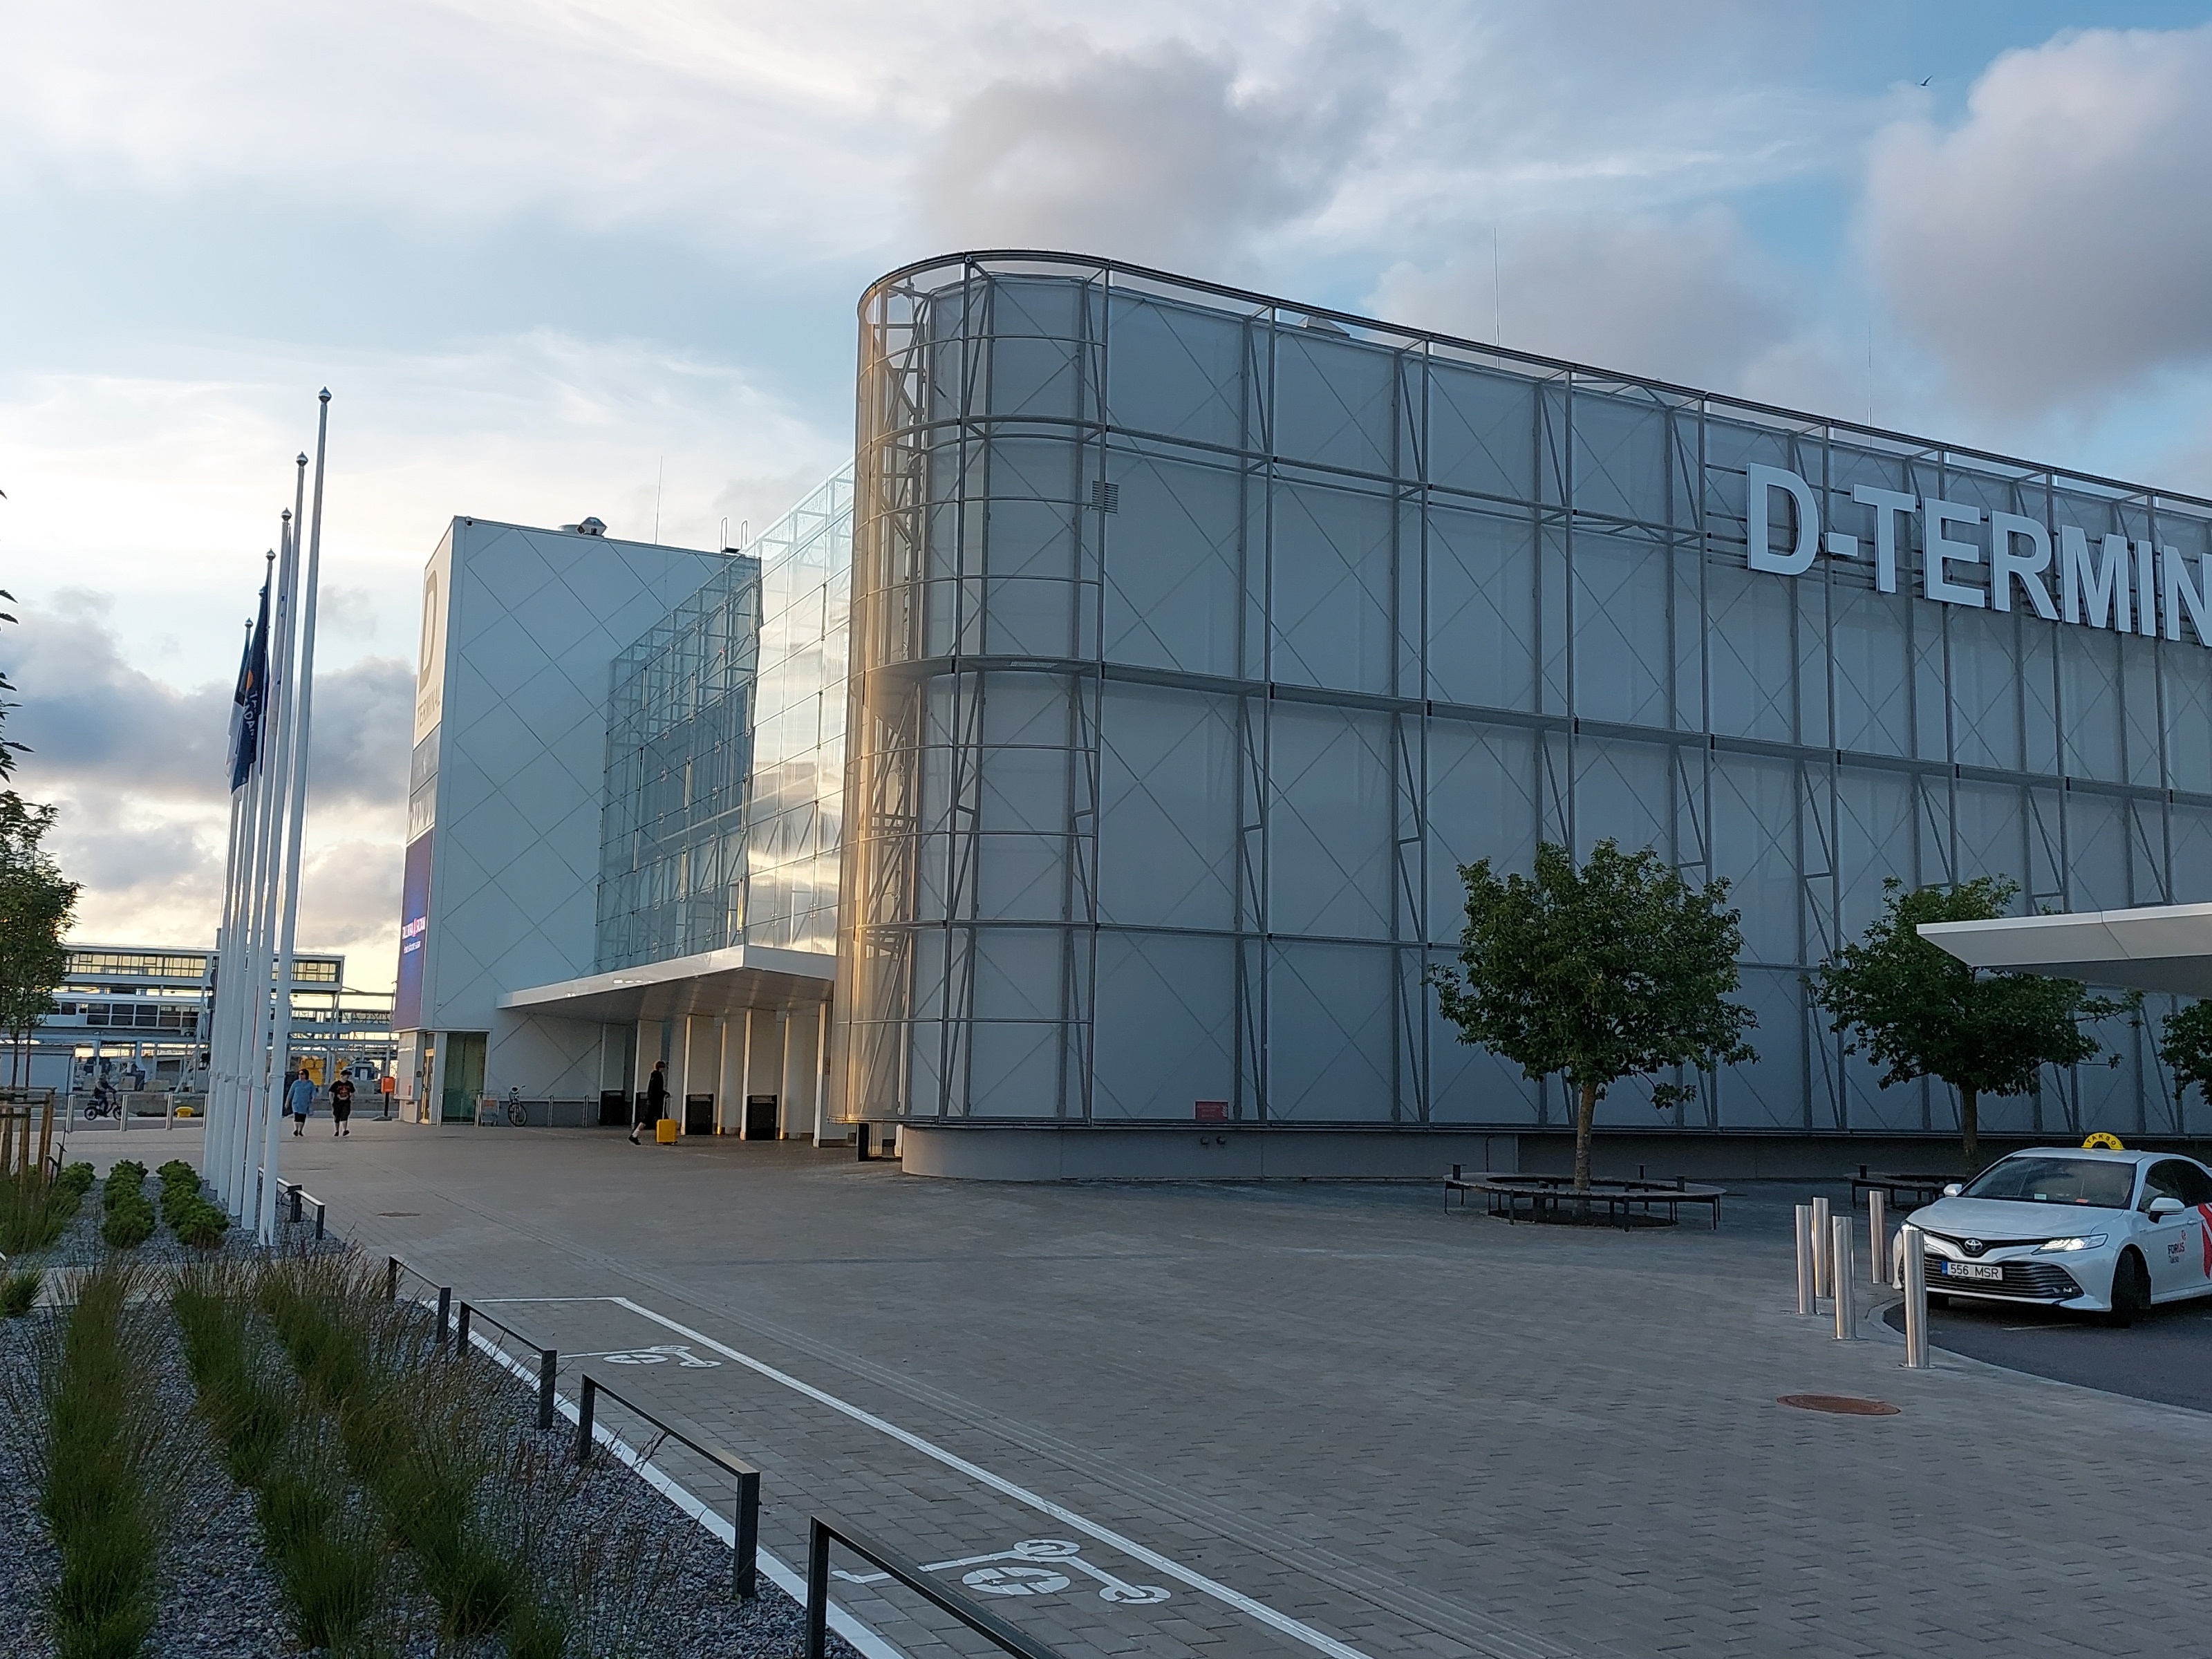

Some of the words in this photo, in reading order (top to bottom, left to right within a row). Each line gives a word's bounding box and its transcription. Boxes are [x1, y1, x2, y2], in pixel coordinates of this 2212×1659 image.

[1746, 462, 2212, 648] D-TERMIN
[418, 569, 438, 695] D
[2086, 1134, 2117, 1145] TAKSO
[1950, 1264, 1969, 1275] 556
[1975, 1266, 1999, 1279] MSR
